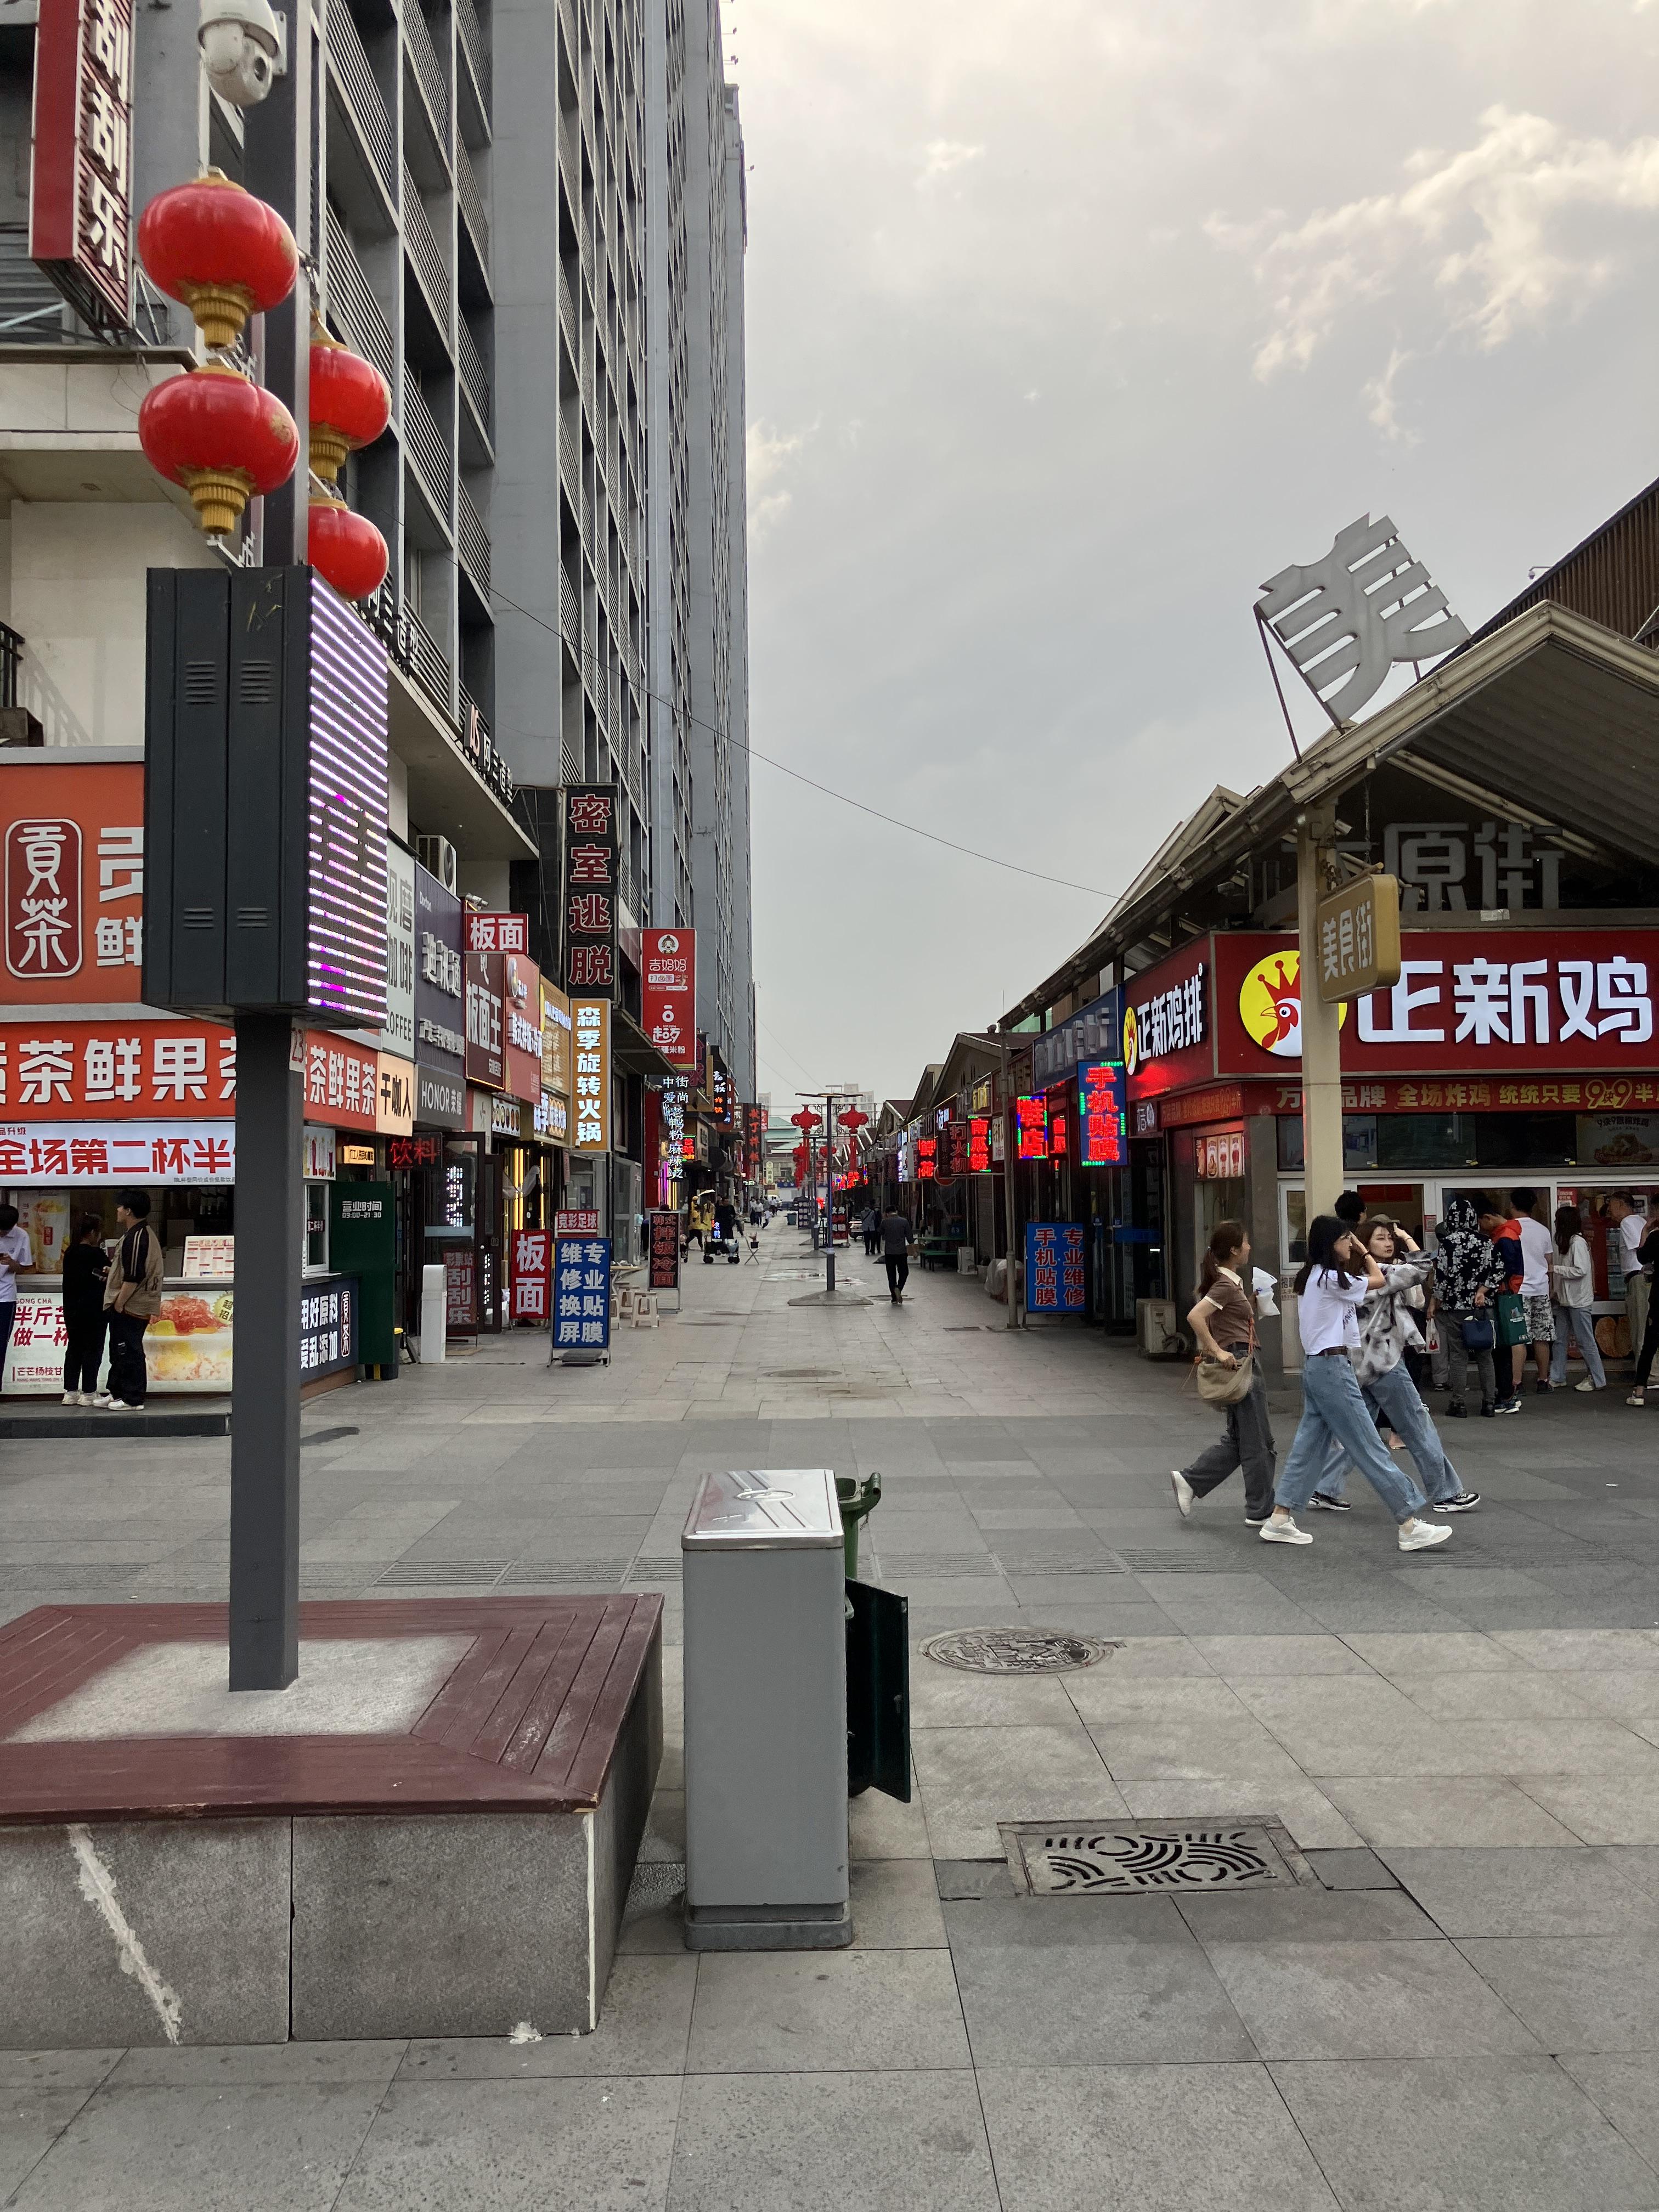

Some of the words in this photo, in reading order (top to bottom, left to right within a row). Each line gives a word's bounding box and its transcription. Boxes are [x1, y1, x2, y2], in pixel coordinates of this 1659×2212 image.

[1254, 512, 1472, 727] 美
[568, 793, 613, 985] 密室逃脱
[470, 917, 524, 951] 板面
[649, 958, 687, 972] 吉妈妈
[1323, 900, 1372, 983] 美食街
[1137, 974, 1203, 1062] 正新鸡排
[1357, 956, 1653, 1044] 正新鸡
[0, 1036, 236, 1103] 茶鲜果
[304, 1043, 376, 1116] 茶鲜果茶
[577, 1007, 602, 1143] 森季旋转火锅
[653, 1045, 686, 1054] 疆米粉
[421, 1079, 450, 1114] HONOR
[1085, 1066, 1119, 1161] 手机贴膜
[1397, 1084, 1491, 1108] 全场炸鸡
[1499, 1084, 1581, 1104] 统统只要
[0, 1138, 236, 1175] 全场第二杯半
[390, 1137, 437, 1165] 饮料
[949, 1125, 967, 1173] 打火机
[970, 1118, 989, 1170] 南瓜饼
[342, 1200, 382, 1212] 营业时间
[558, 1212, 597, 1229] 竞彩足球
[516, 1233, 546, 1315] 板面
[652, 1226, 676, 1286] 拌饭冷面
[1034, 1227, 1058, 1306] 手机贴膜
[1062, 1227, 1085, 1307] 专业维修
[447, 1267, 472, 1324] 刮刮乐
[557, 1242, 583, 1343] 维修换屏
[581, 1242, 606, 1344] 专业贴膜
